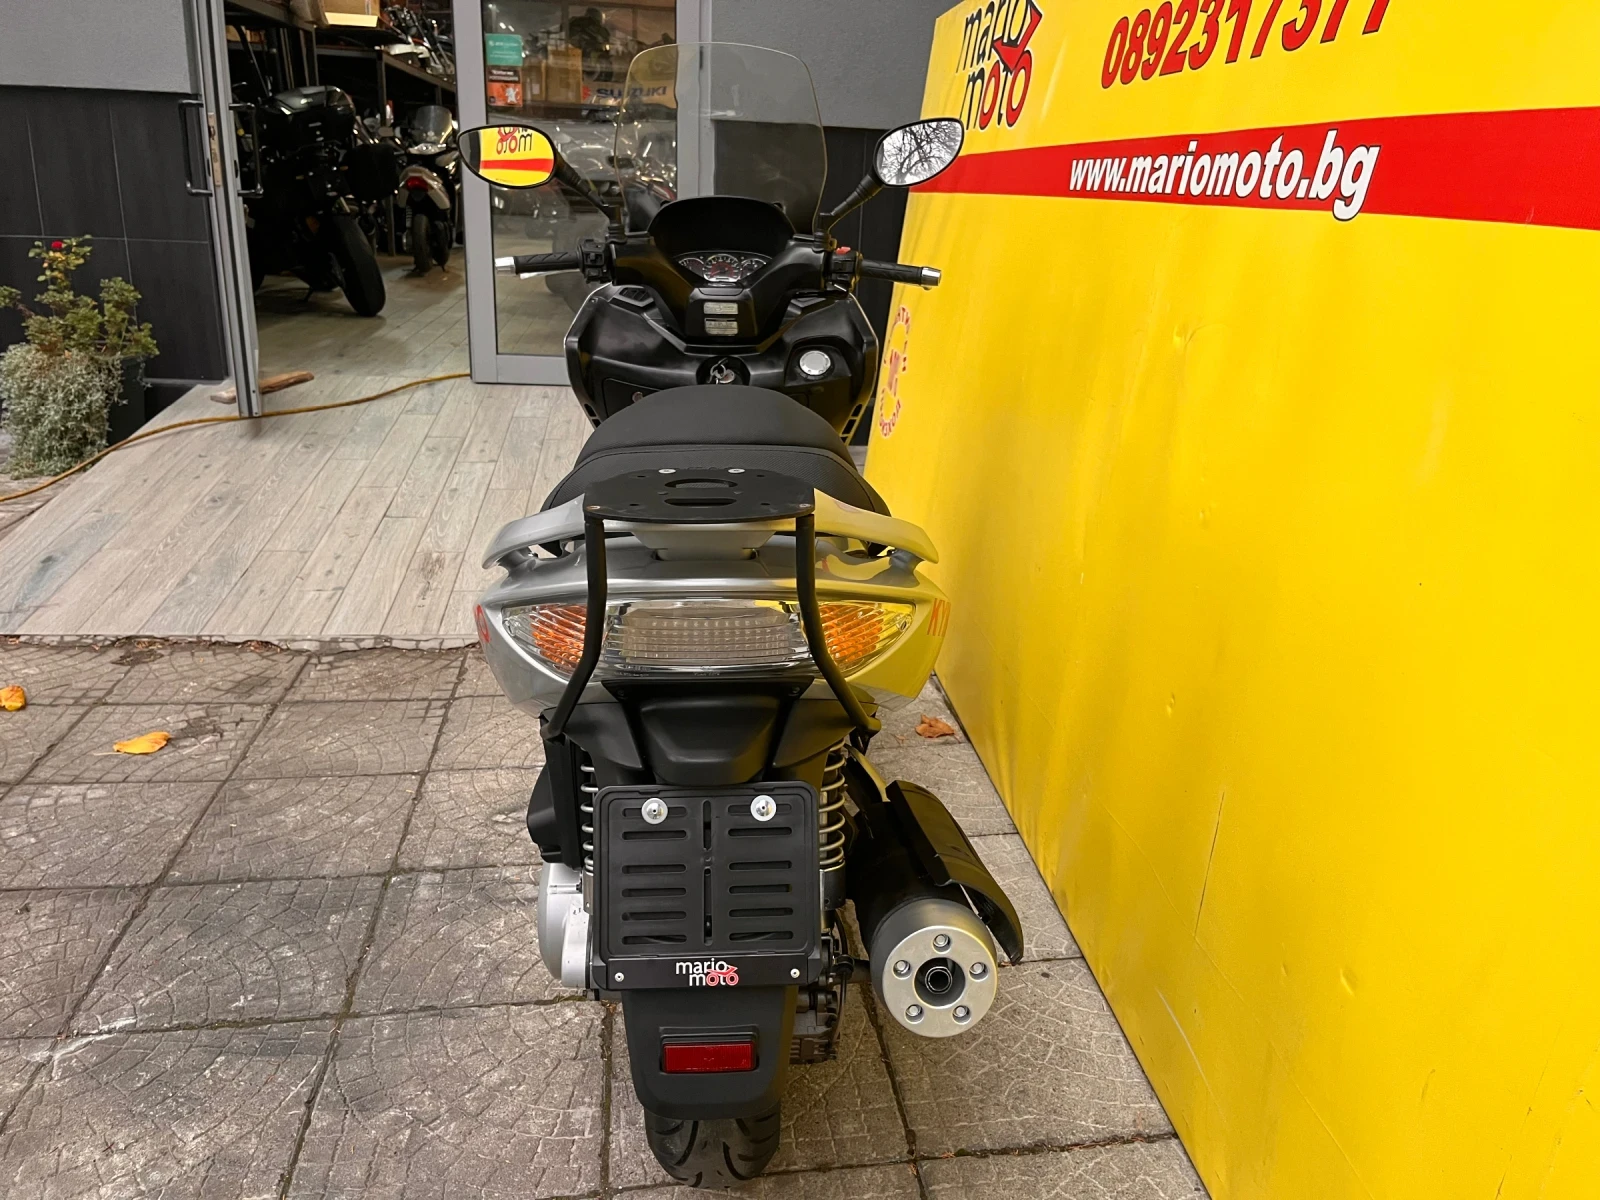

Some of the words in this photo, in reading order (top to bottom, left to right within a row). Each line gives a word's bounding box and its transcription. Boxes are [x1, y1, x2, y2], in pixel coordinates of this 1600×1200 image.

[596, 86, 667, 99] SUZUKI
[959, 49, 1033, 130] moto
[1069, 129, 1382, 221] www.mariomoto.bg
[675, 957, 728, 974] mario
[689, 972, 739, 986] moto
